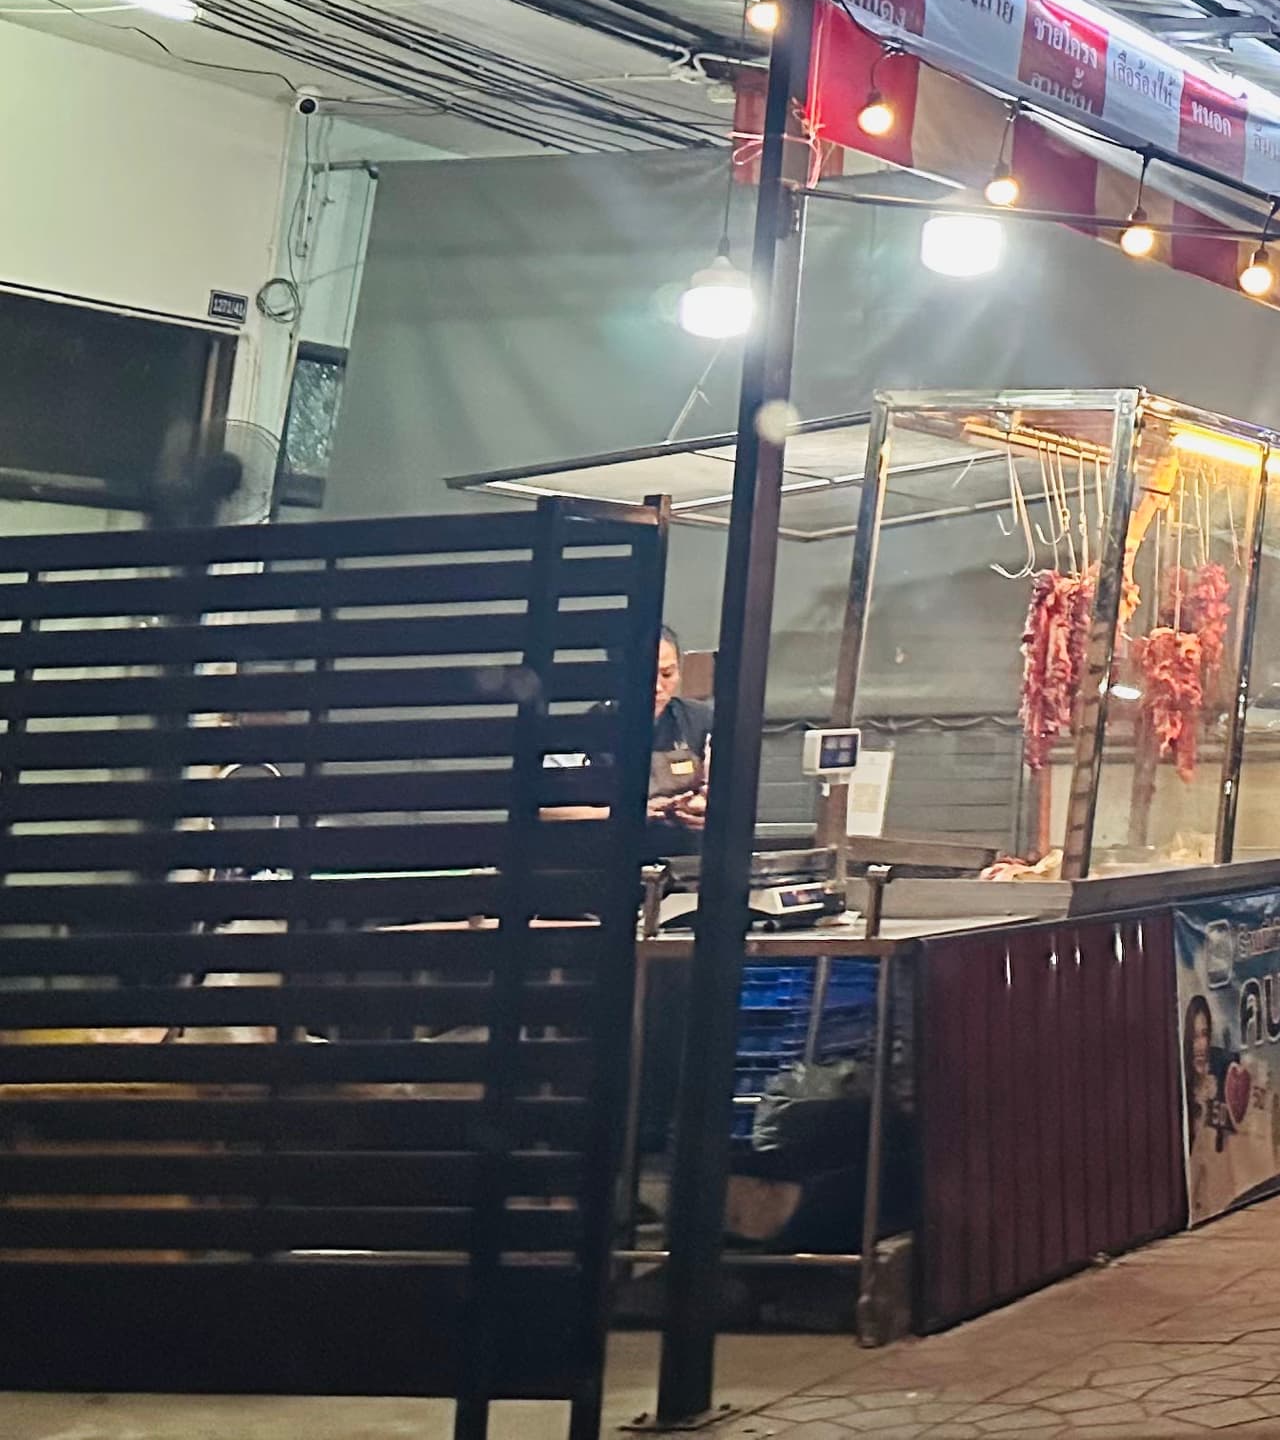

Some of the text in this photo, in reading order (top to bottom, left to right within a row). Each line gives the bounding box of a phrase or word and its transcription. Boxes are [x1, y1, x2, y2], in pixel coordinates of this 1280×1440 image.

[1034, 17, 1098, 69] ชายโครง
[1113, 50, 1176, 107] เสือร้องไห้
[1191, 100, 1231, 138] หนอก
